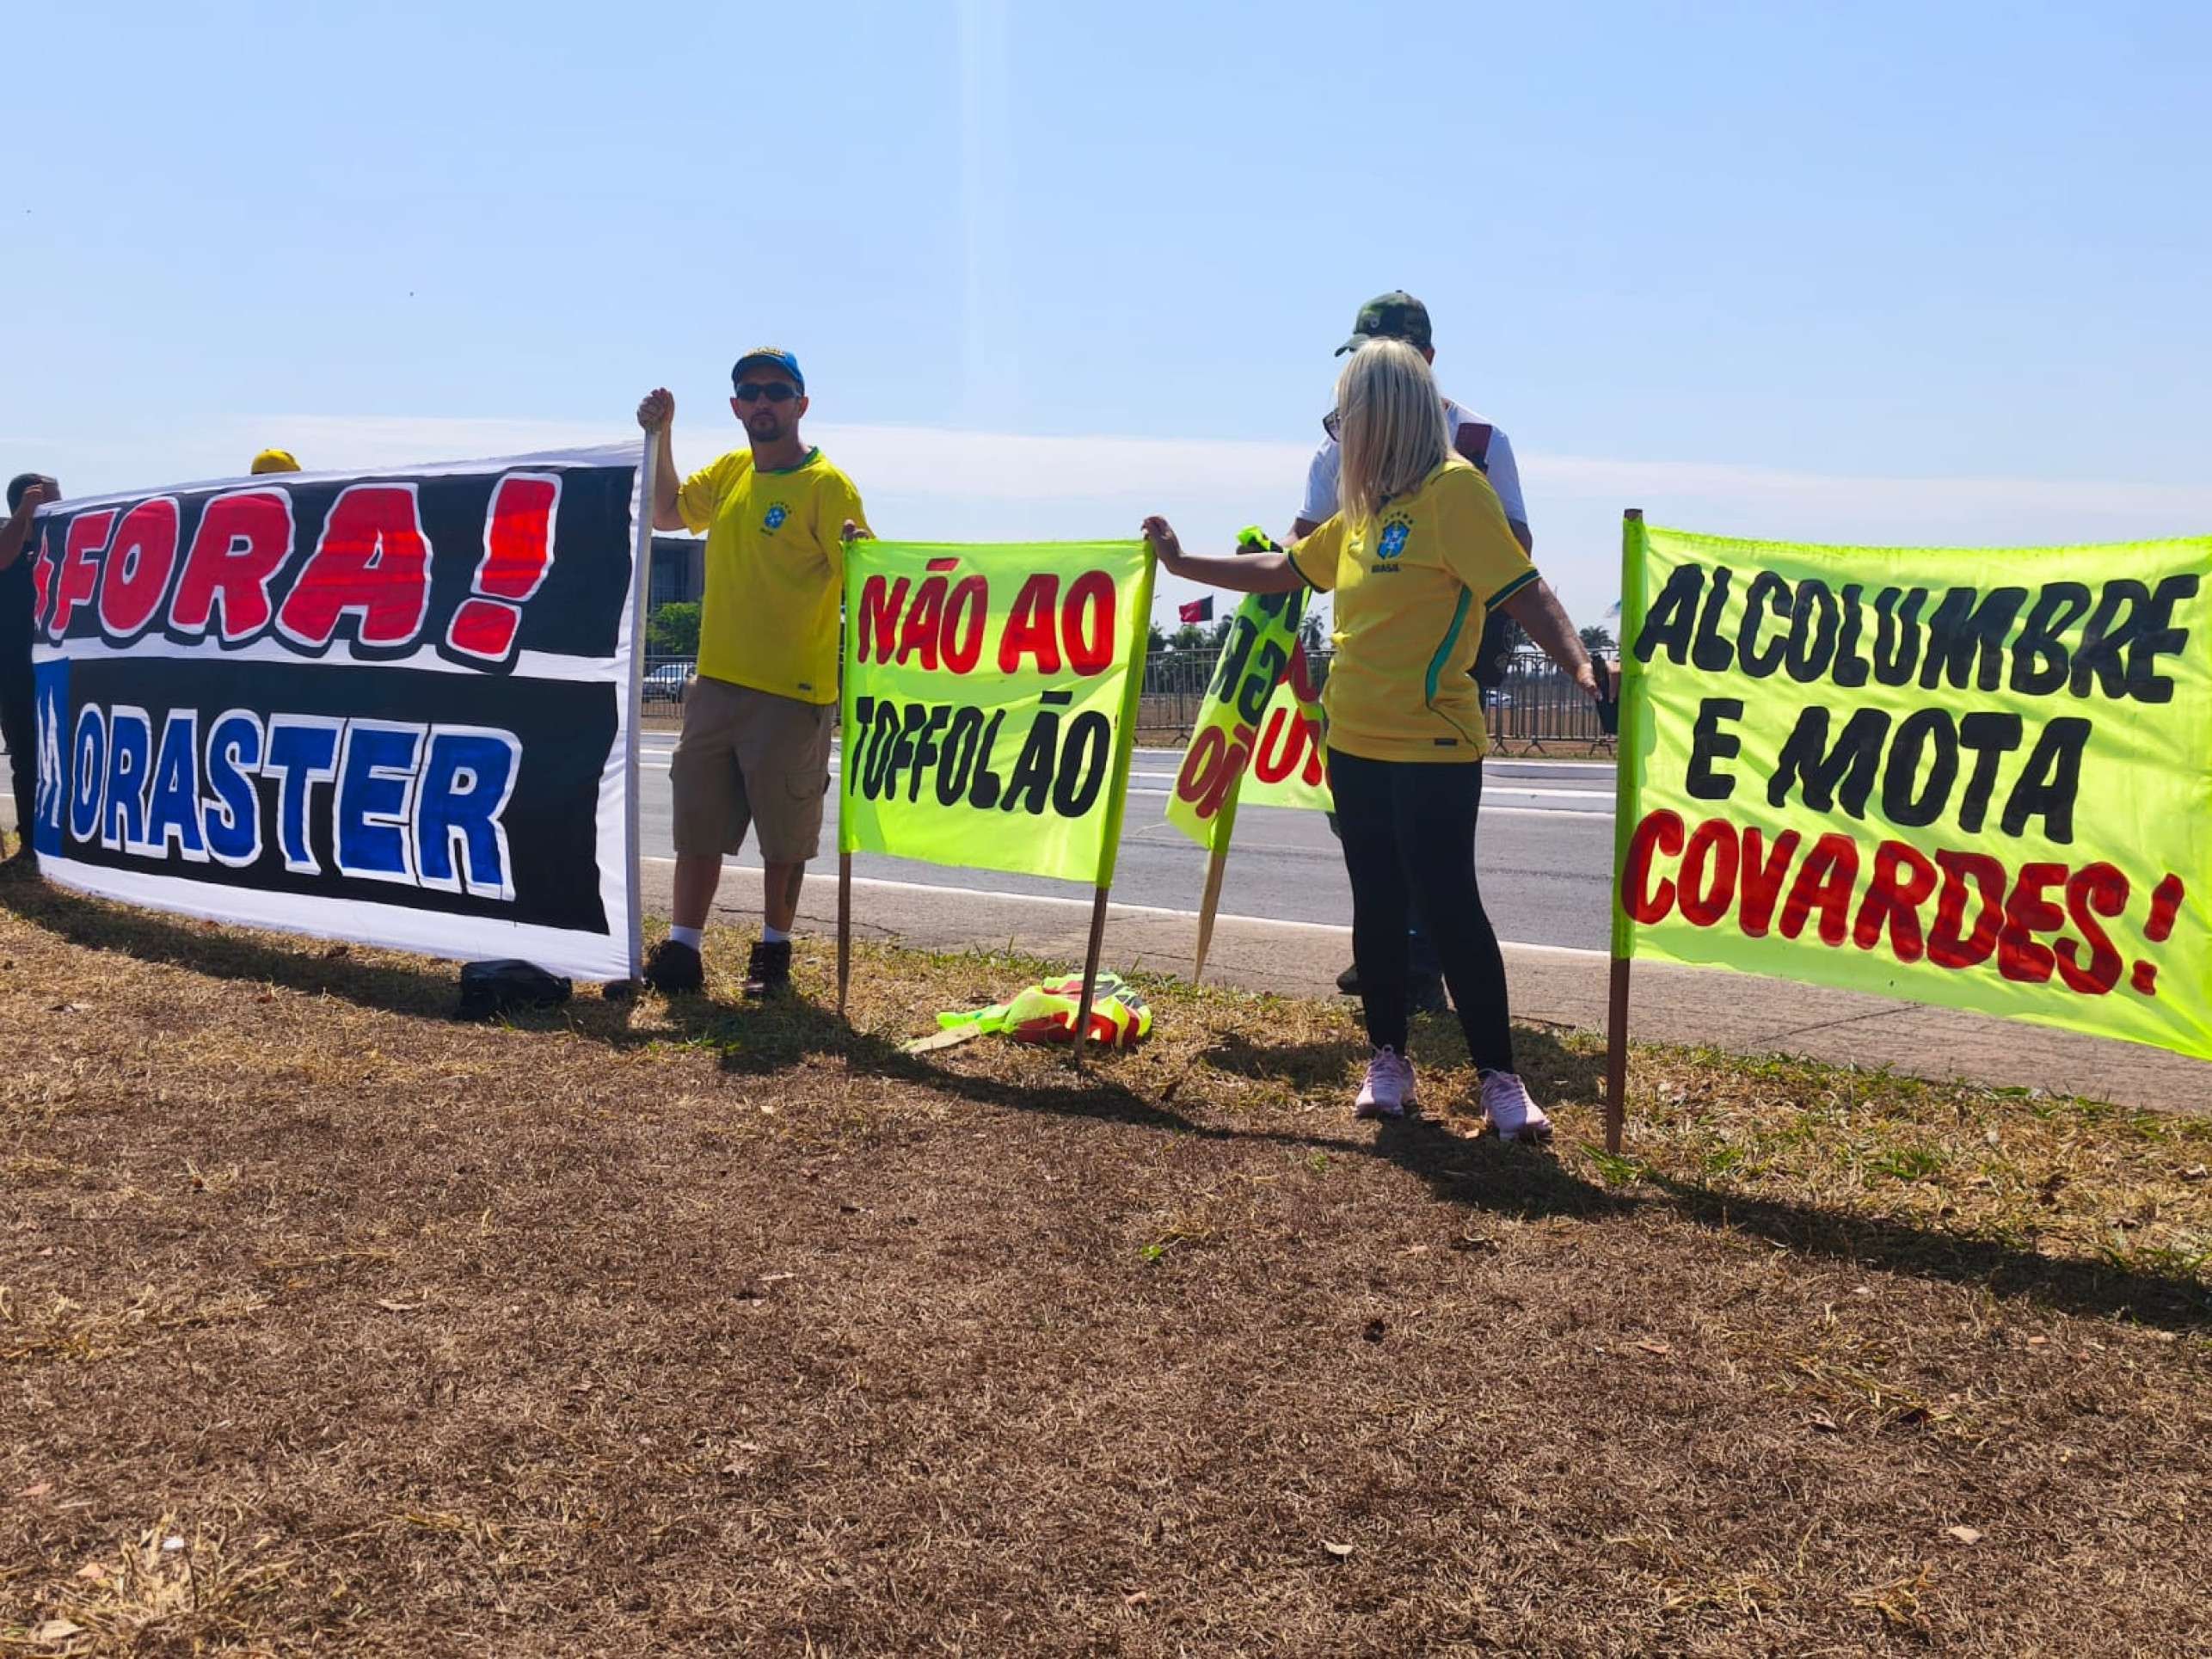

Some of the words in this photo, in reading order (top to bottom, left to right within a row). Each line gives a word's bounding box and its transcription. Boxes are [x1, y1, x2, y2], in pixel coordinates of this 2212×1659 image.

[857, 557, 988, 674] NÃO
[998, 570, 1116, 676] AO
[1634, 564, 2199, 704] ALCOLUMBRE
[850, 691, 1111, 817] TOFFOLÃO
[1685, 697, 1744, 799] E
[1767, 706, 2092, 845] MOTA
[1621, 808, 2184, 996] COVARDES!
